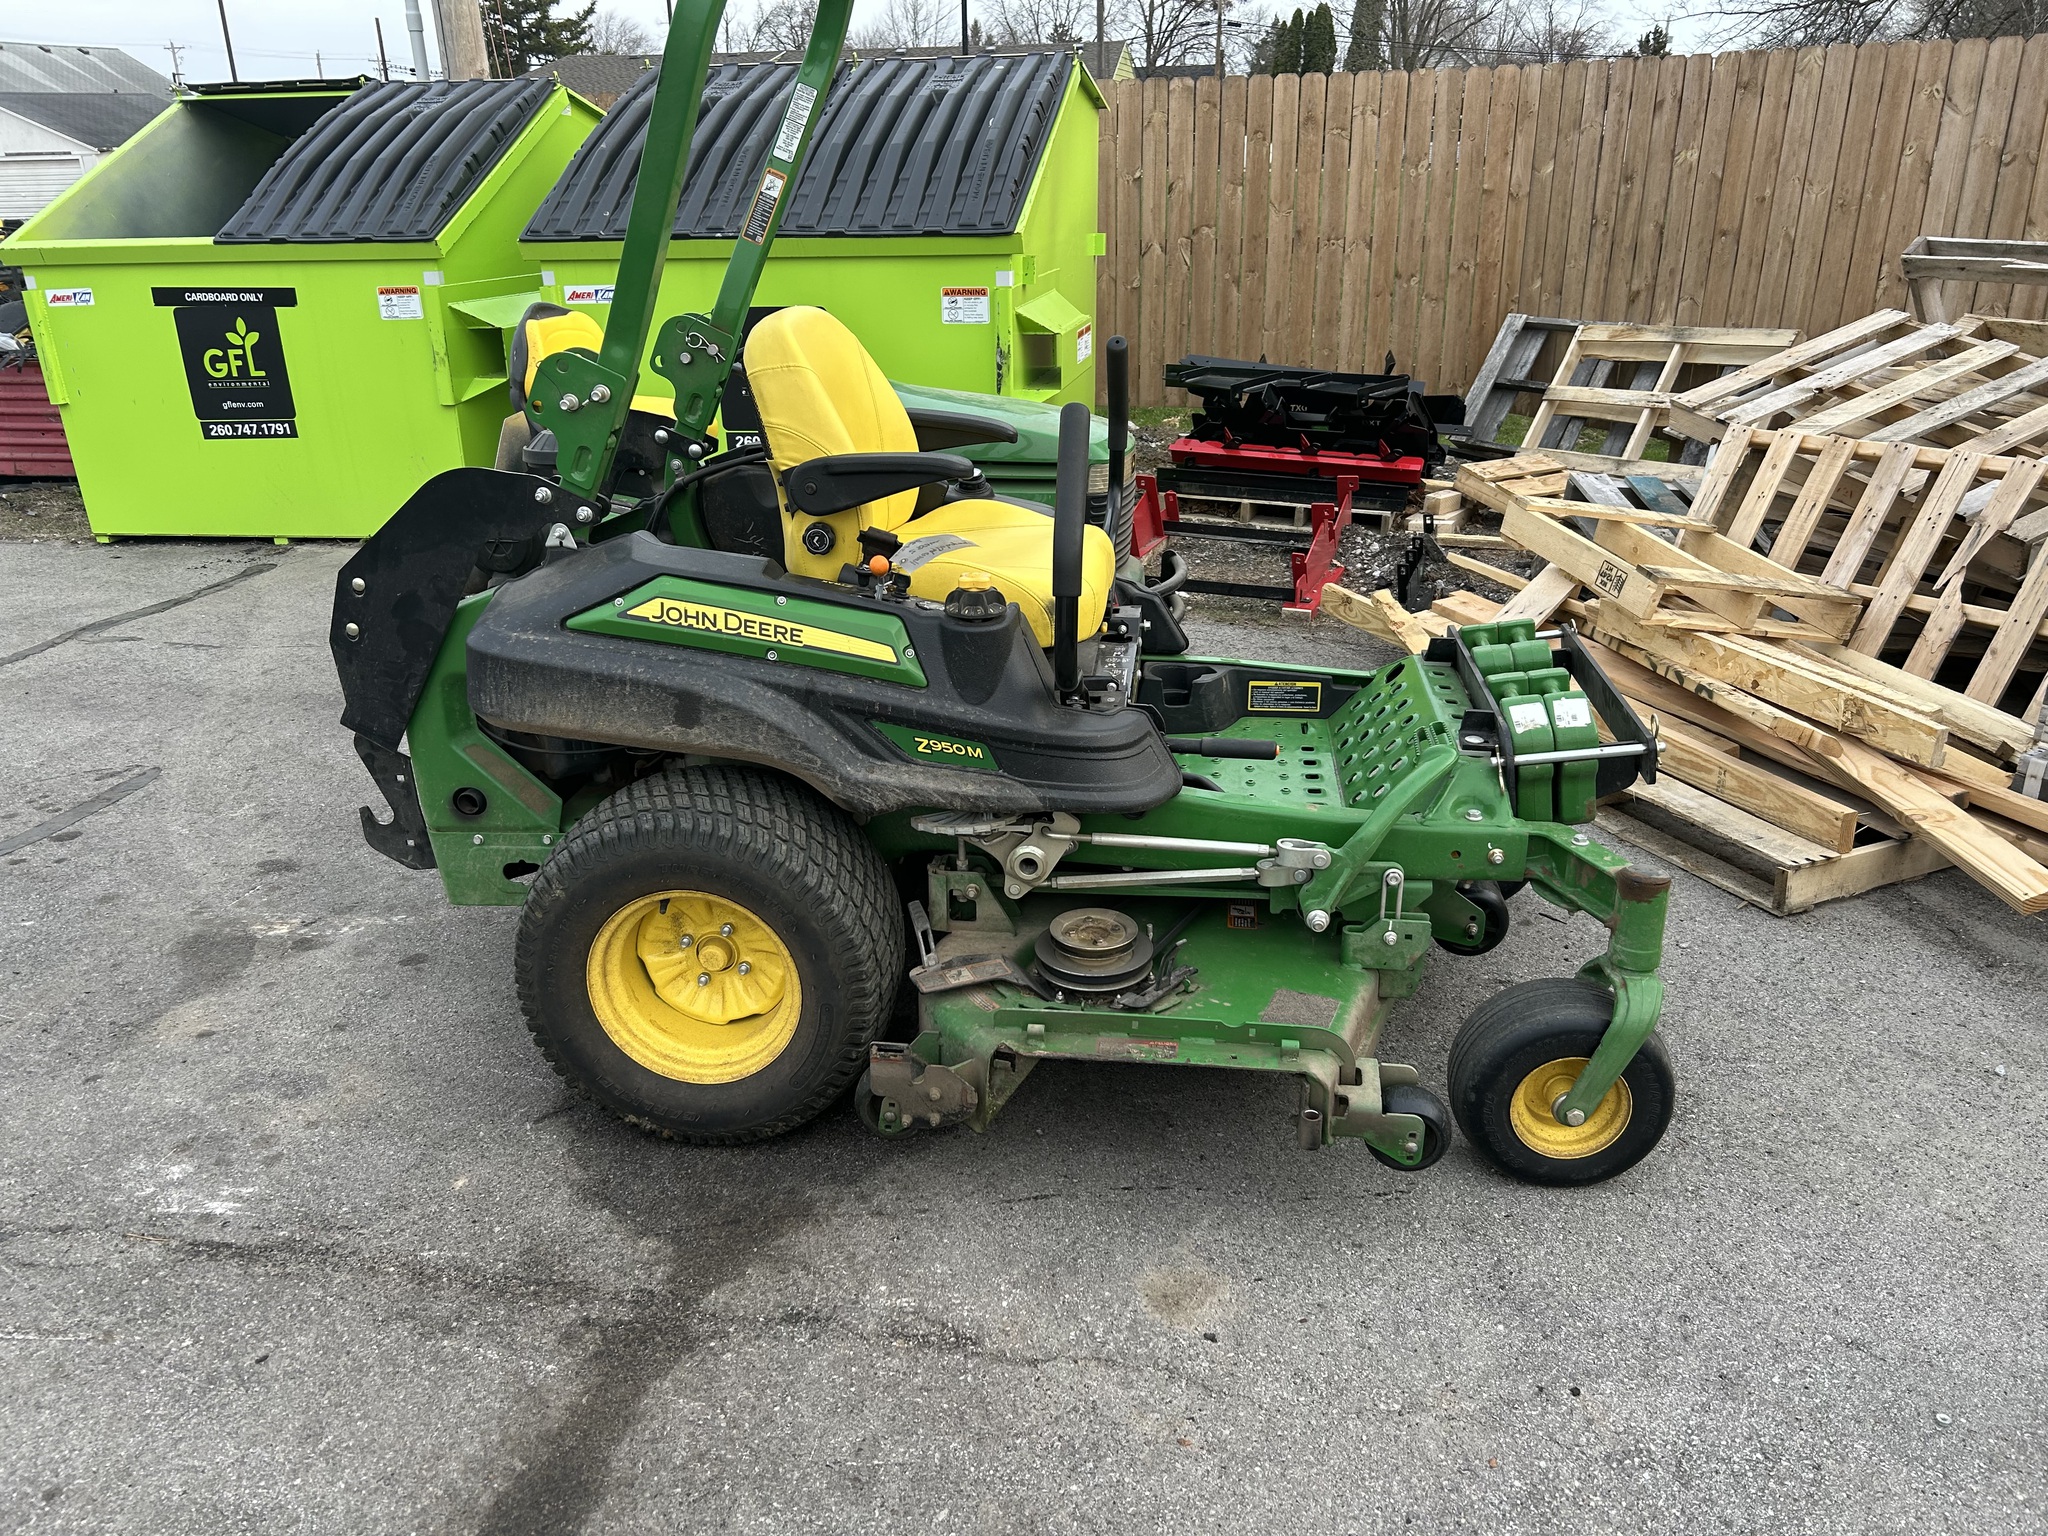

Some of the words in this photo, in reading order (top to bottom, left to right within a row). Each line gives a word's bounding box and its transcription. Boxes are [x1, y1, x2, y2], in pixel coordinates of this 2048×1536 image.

[384, 287, 417, 295] WARNING
[950, 288, 986, 296] WARNING
[184, 292, 239, 302] CARDBOARD
[240, 293, 264, 302] ONLY
[203, 338, 266, 379] GFL
[208, 380, 270, 388] environmental
[222, 400, 264, 410] gflenv.com
[209, 423, 291, 436] 260.747.1791
[651, 601, 718, 630] JOHN
[724, 612, 804, 644] DEERE
[913, 736, 984, 759] Z950M
